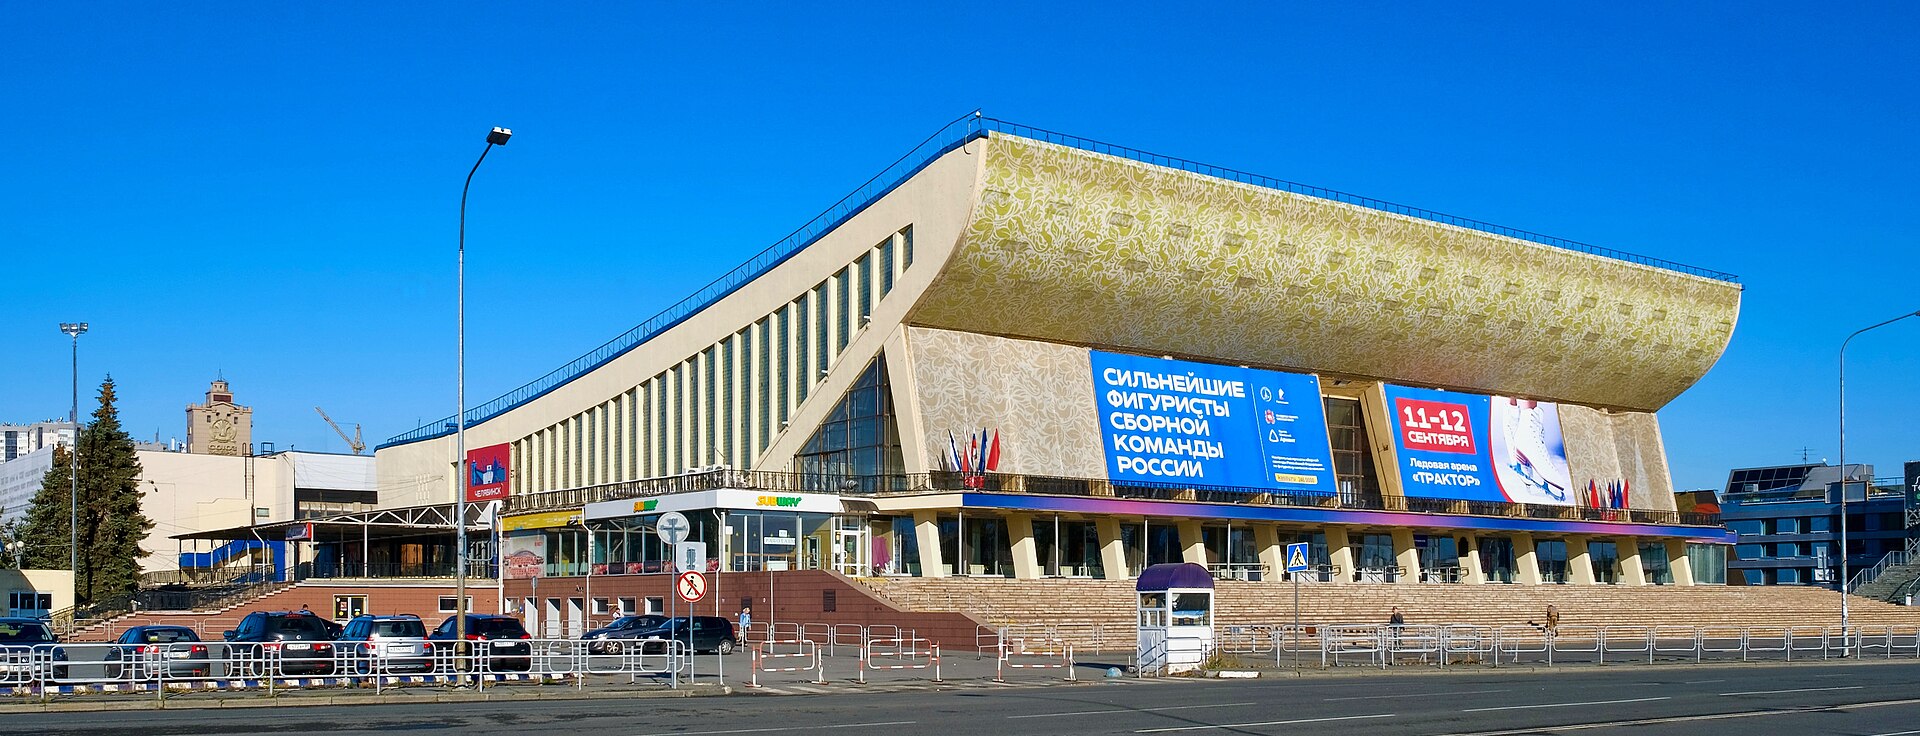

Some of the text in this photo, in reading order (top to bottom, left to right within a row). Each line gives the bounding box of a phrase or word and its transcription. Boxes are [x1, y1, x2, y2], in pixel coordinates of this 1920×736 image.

[1104, 368, 1245, 397] СИЛЬНЕЙШИЕ
[1106, 389, 1230, 418] ФИГУРИСТЫ
[1110, 411, 1210, 437] СБОРНОЙ
[1404, 406, 1466, 432] 11-12
[1113, 433, 1225, 461] КОМАНДЫ
[1408, 431, 1469, 447] СЕНТЯБРЯ
[1116, 455, 1204, 478] РОССИИ
[1410, 458, 1478, 472] Ледовая арена
[1412, 472, 1480, 486] «ТРАКТОР»
[474, 487, 502, 498] ЧЕЛЯБИНСК
[756, 495, 802, 508] SUBWAY
